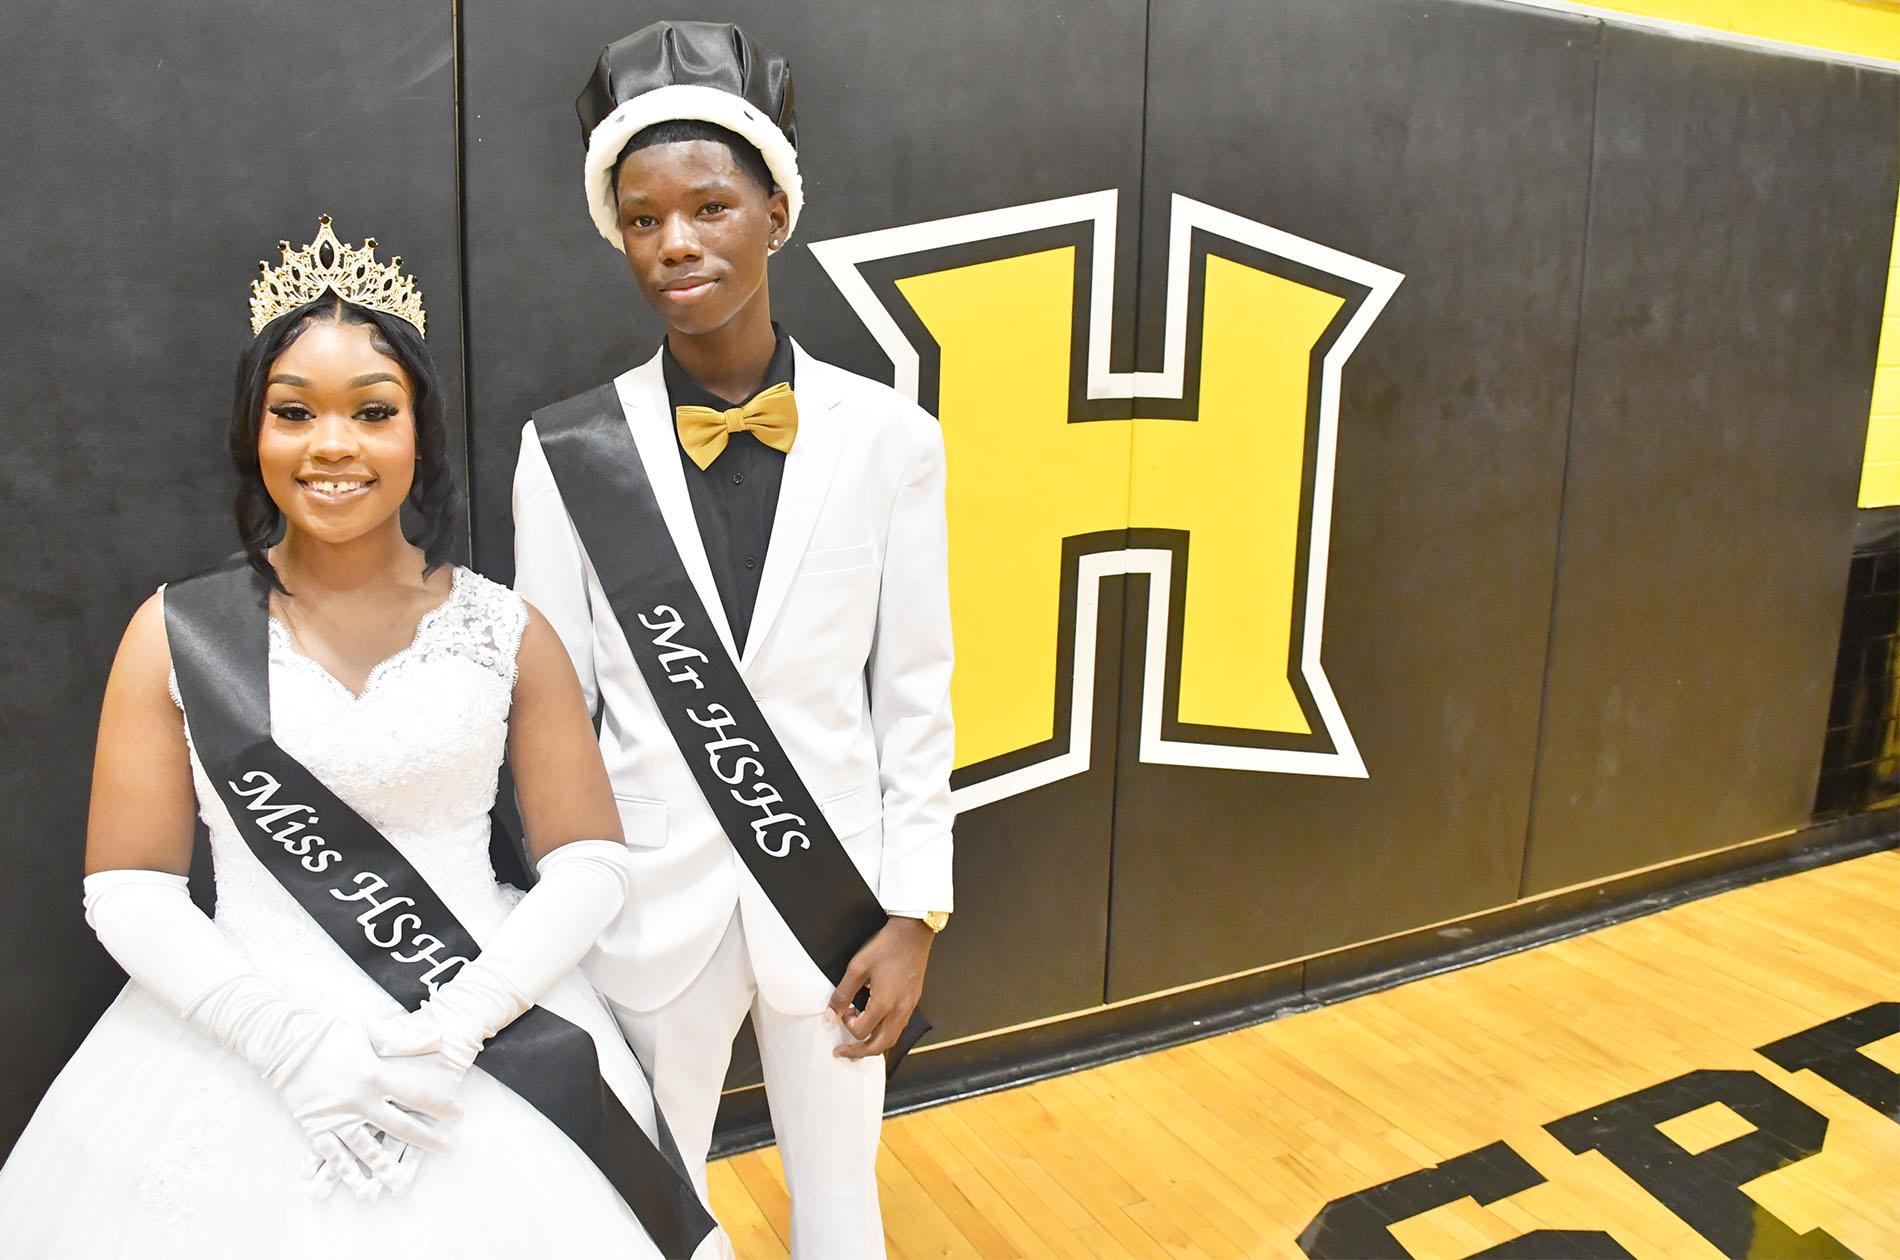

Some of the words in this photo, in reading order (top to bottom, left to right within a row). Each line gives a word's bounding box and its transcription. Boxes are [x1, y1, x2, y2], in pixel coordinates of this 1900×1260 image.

[807, 188, 1405, 816] H
[637, 604, 709, 690] Mr
[686, 703, 811, 858] HSHS
[228, 770, 343, 873] Miss
[329, 871, 467, 993] HSH
